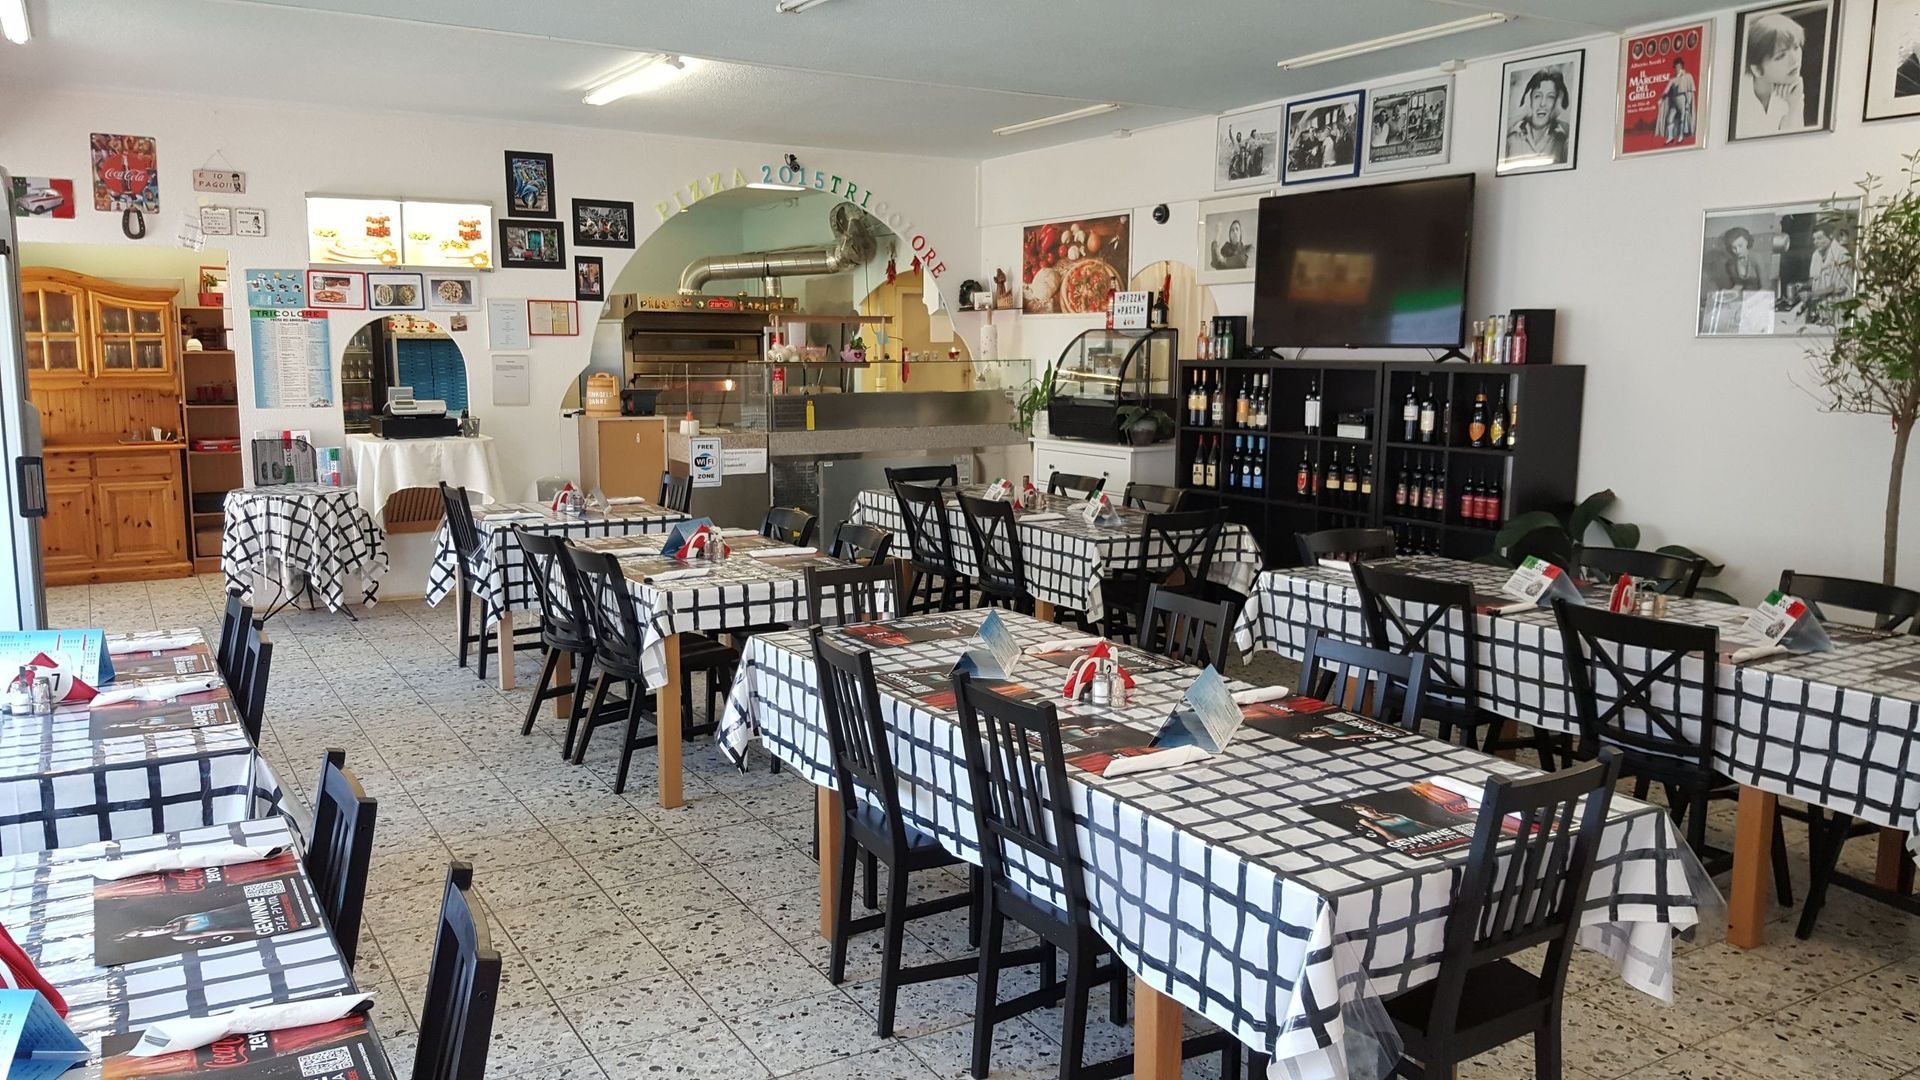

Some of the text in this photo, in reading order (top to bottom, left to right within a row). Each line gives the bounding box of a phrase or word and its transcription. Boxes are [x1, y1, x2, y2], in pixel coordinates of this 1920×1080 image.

[1629, 90, 1656, 101] GRILLO
[655, 167, 747, 223] PIZZA
[761, 164, 825, 190] 2015
[1122, 294, 1141, 303] PIZZA
[255, 310, 320, 318] TRICOLORE
[1121, 306, 1140, 315] PASTA
[51, 673, 60, 691] 7
[1386, 827, 1457, 848] GEWINNE
[205, 867, 222, 883] zero
[247, 897, 275, 935] GEWINNE
[248, 1032, 268, 1051] zer
